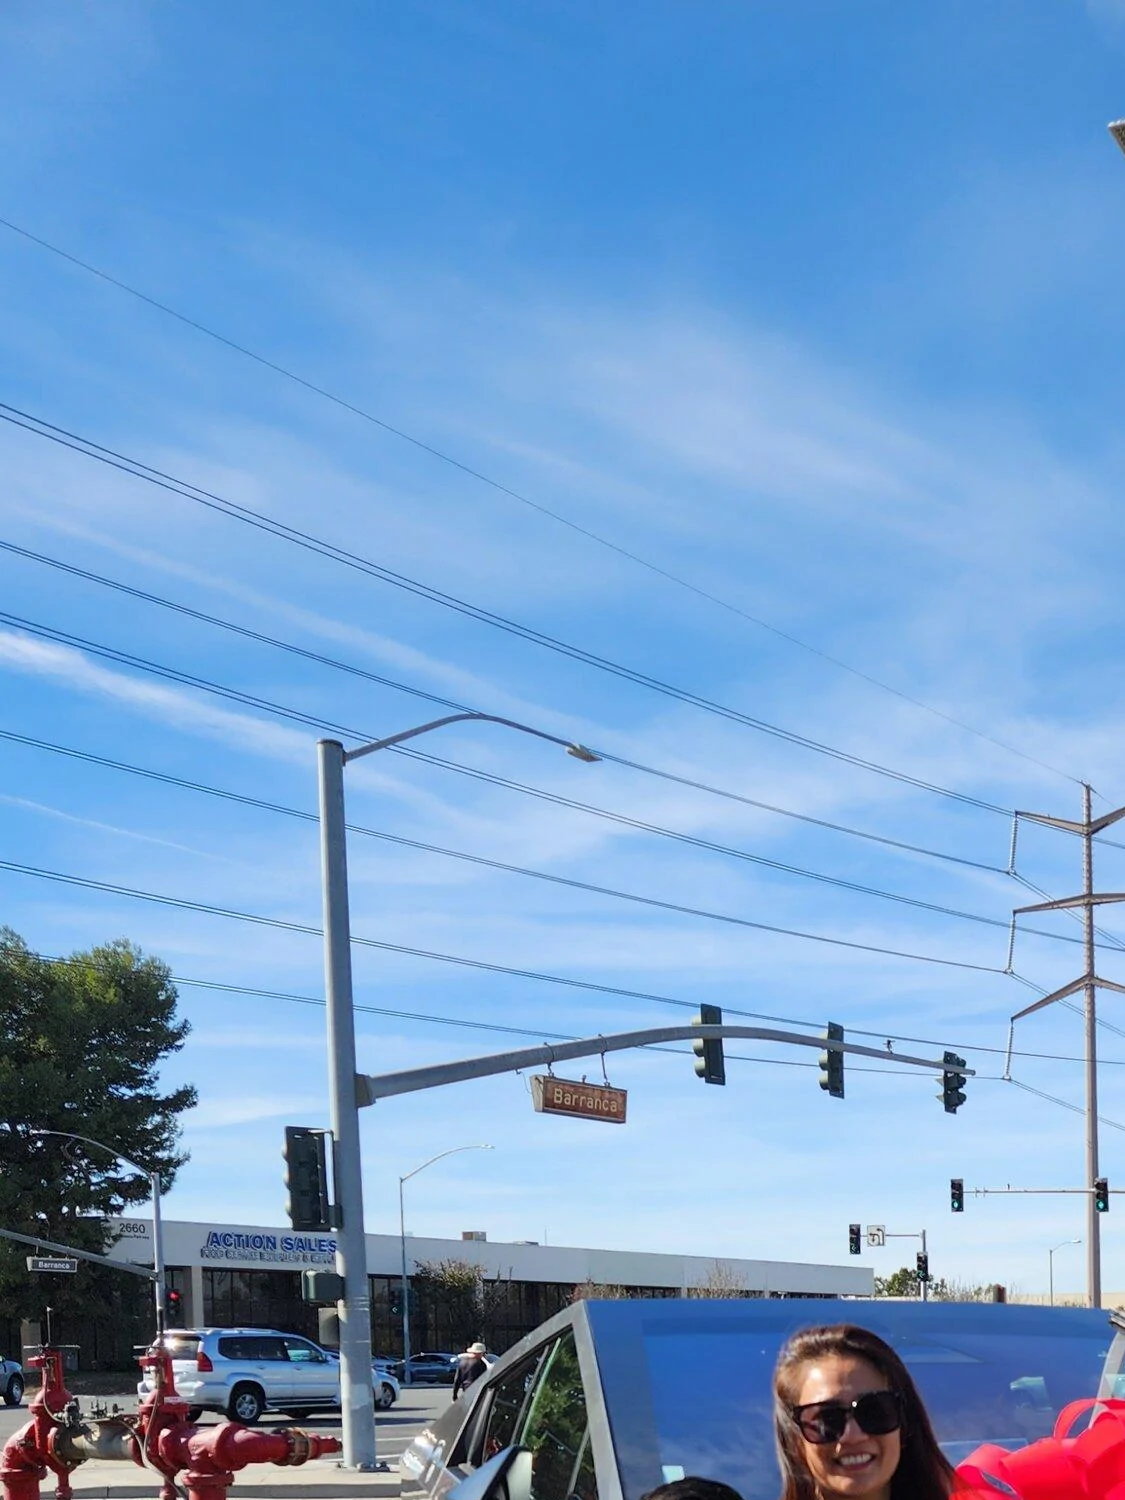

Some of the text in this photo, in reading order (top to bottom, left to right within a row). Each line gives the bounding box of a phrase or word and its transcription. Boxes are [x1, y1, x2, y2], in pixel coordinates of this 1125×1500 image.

[553, 1087, 618, 1113] Barranca
[119, 1222, 146, 1234] 2660
[207, 1232, 337, 1253] ACTION SALES
[38, 1260, 71, 1270] Barranca
